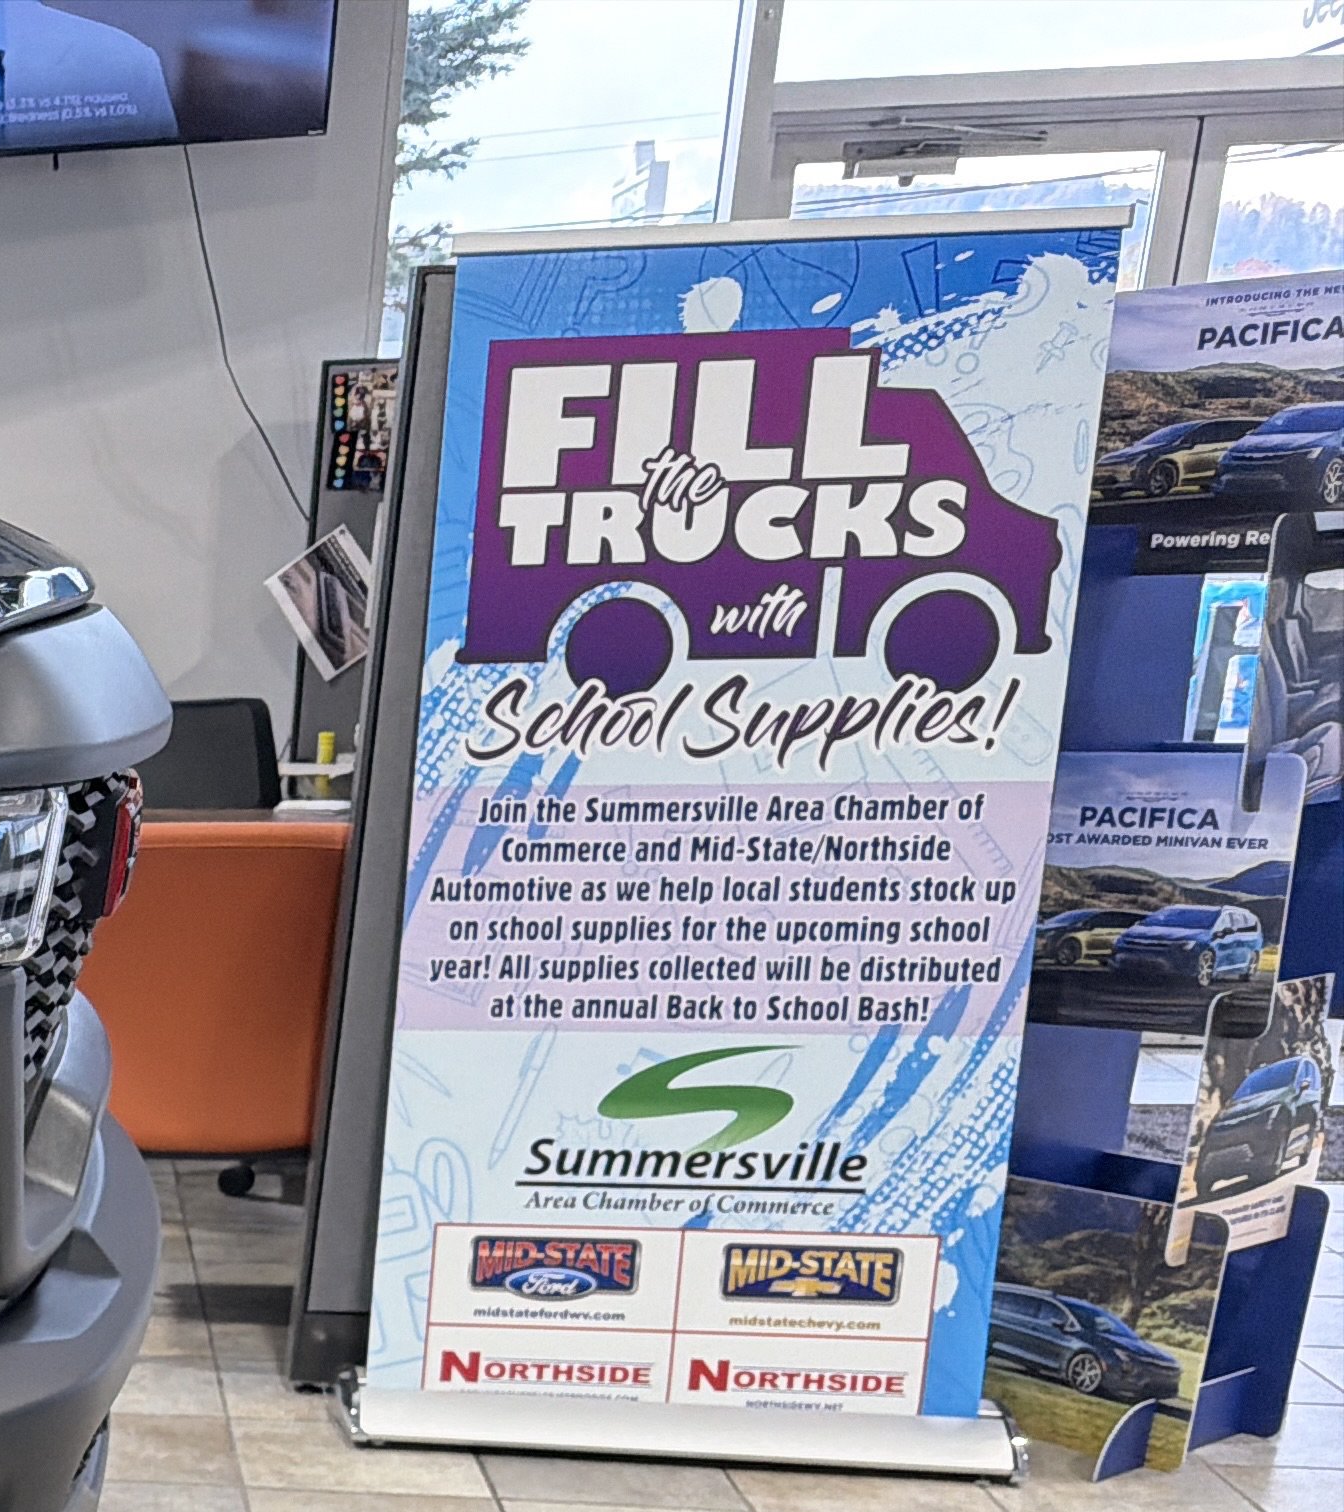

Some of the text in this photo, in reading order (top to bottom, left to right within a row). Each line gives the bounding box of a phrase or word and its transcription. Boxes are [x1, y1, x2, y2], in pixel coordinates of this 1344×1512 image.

[1205, 284, 1344, 307] INTRODUCING THE NE
[1197, 315, 1344, 351] PACIFICA
[502, 354, 910, 489] FILL
[641, 446, 722, 512] the
[499, 480, 968, 567] TRUCKS
[1150, 530, 1240, 549] Powering
[710, 583, 810, 639] with
[465, 675, 1021, 772] School Supplies!
[478, 793, 984, 824] Join the Summersville Area Chamber of
[1079, 806, 1220, 831] PACIFICA
[501, 833, 952, 865] Commerce and Mid-State/Northside
[1075, 833, 1152, 847] AWARDED
[1156, 835, 1222, 849] MINIVAN
[1226, 837, 1269, 851] EVER
[429, 874, 1017, 905] Automotive as we help local students stock up
[449, 915, 991, 945] on school supplies for the upcoming school
[429, 954, 1002, 983] year! All supplies collected will be distributed
[490, 993, 930, 1022] at the annual Back to School Bash!
[524, 1137, 868, 1183] Summersville
[522, 1190, 835, 1218] Area Chamber of Commerce
[475, 1239, 632, 1285] MID-STATE
[727, 1247, 896, 1297] MID-STATE
[521, 1271, 579, 1297] Ford
[728, 1315, 881, 1332] midstatechevy.com
[438, 1350, 653, 1386] NORTHSIDE
[687, 1358, 906, 1394] NORTHSIDE
